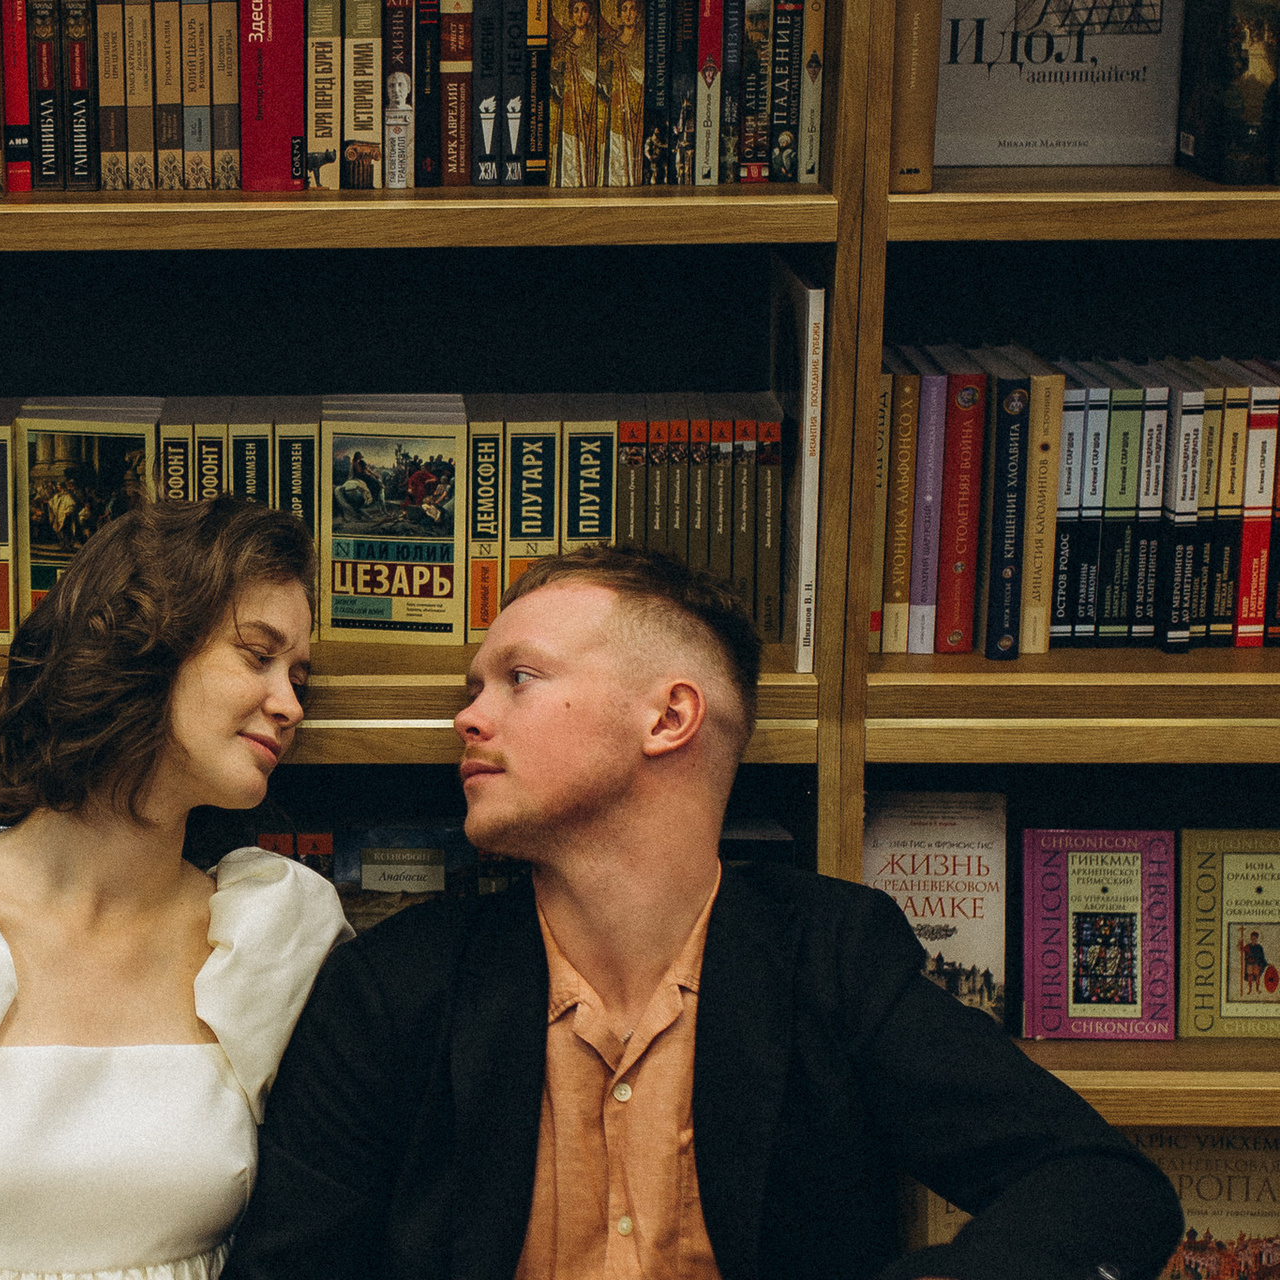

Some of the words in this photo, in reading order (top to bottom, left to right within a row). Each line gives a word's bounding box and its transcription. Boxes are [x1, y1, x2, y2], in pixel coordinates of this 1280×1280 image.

[186, 18, 197, 59] ЦЕЗАРЬ
[311, 41, 333, 74] БУРЕЙ
[353, 42, 373, 77] РИМА
[388, 10, 405, 64] ЖИЗНЬ
[942, 17, 1098, 81] Идол,
[188, 61, 197, 93] ЮЛИЙ
[314, 77, 334, 109] ПЕРЕД
[744, 72, 756, 110] ДЕНЬ
[773, 15, 790, 125] ПАДЕНИЕ
[1025, 65, 1148, 85] защищайся!
[314, 112, 333, 138] БУРЯ
[353, 79, 375, 131] ИСТОРИЯ
[445, 82, 458, 137] АВРЕЛИЙ
[41, 99, 56, 176] ГАННИБАЛ
[73, 99, 88, 176] ГАННИБАЛ
[447, 140, 458, 173] МАРК
[743, 115, 756, 159] ОДИН
[957, 419, 975, 470] ВОЙНА
[1006, 423, 1020, 488] ХЛОДВИГА
[245, 443, 256, 494] МОММЗЕН
[291, 443, 302, 495] МОММЗЕН
[475, 441, 496, 534] ДЕМОСФЕН
[520, 440, 544, 534] ПЛУТАРХ
[578, 440, 601, 534] ПЛУТАРХ
[954, 473, 971, 554] СТОЛЕТНЯЯ
[1033, 459, 1049, 535] КАРОЛИНГОВ
[1003, 492, 1018, 559] КРЕЩЕНИЕ
[356, 543, 390, 561] ГАЙ
[395, 542, 452, 561] ЮЛИЙ
[1031, 540, 1045, 603] ДИНАСТИЯ
[1058, 533, 1070, 571] РОДОС
[333, 564, 453, 597] ЦЕЗАРЬ
[1056, 574, 1069, 618] ОСТРОВ
[877, 854, 990, 876] ЖИЗНЬ
[1040, 836, 1138, 850] CHRONICON
[1070, 854, 1140, 868] ГИНКМАР
[1244, 861, 1274, 870] ИОНА
[378, 872, 429, 881] Анабасис
[1040, 850, 1063, 1034] CHRONICON
[1194, 850, 1216, 1033] CHRONICON
[1071, 1021, 1169, 1035] CHRONICON
